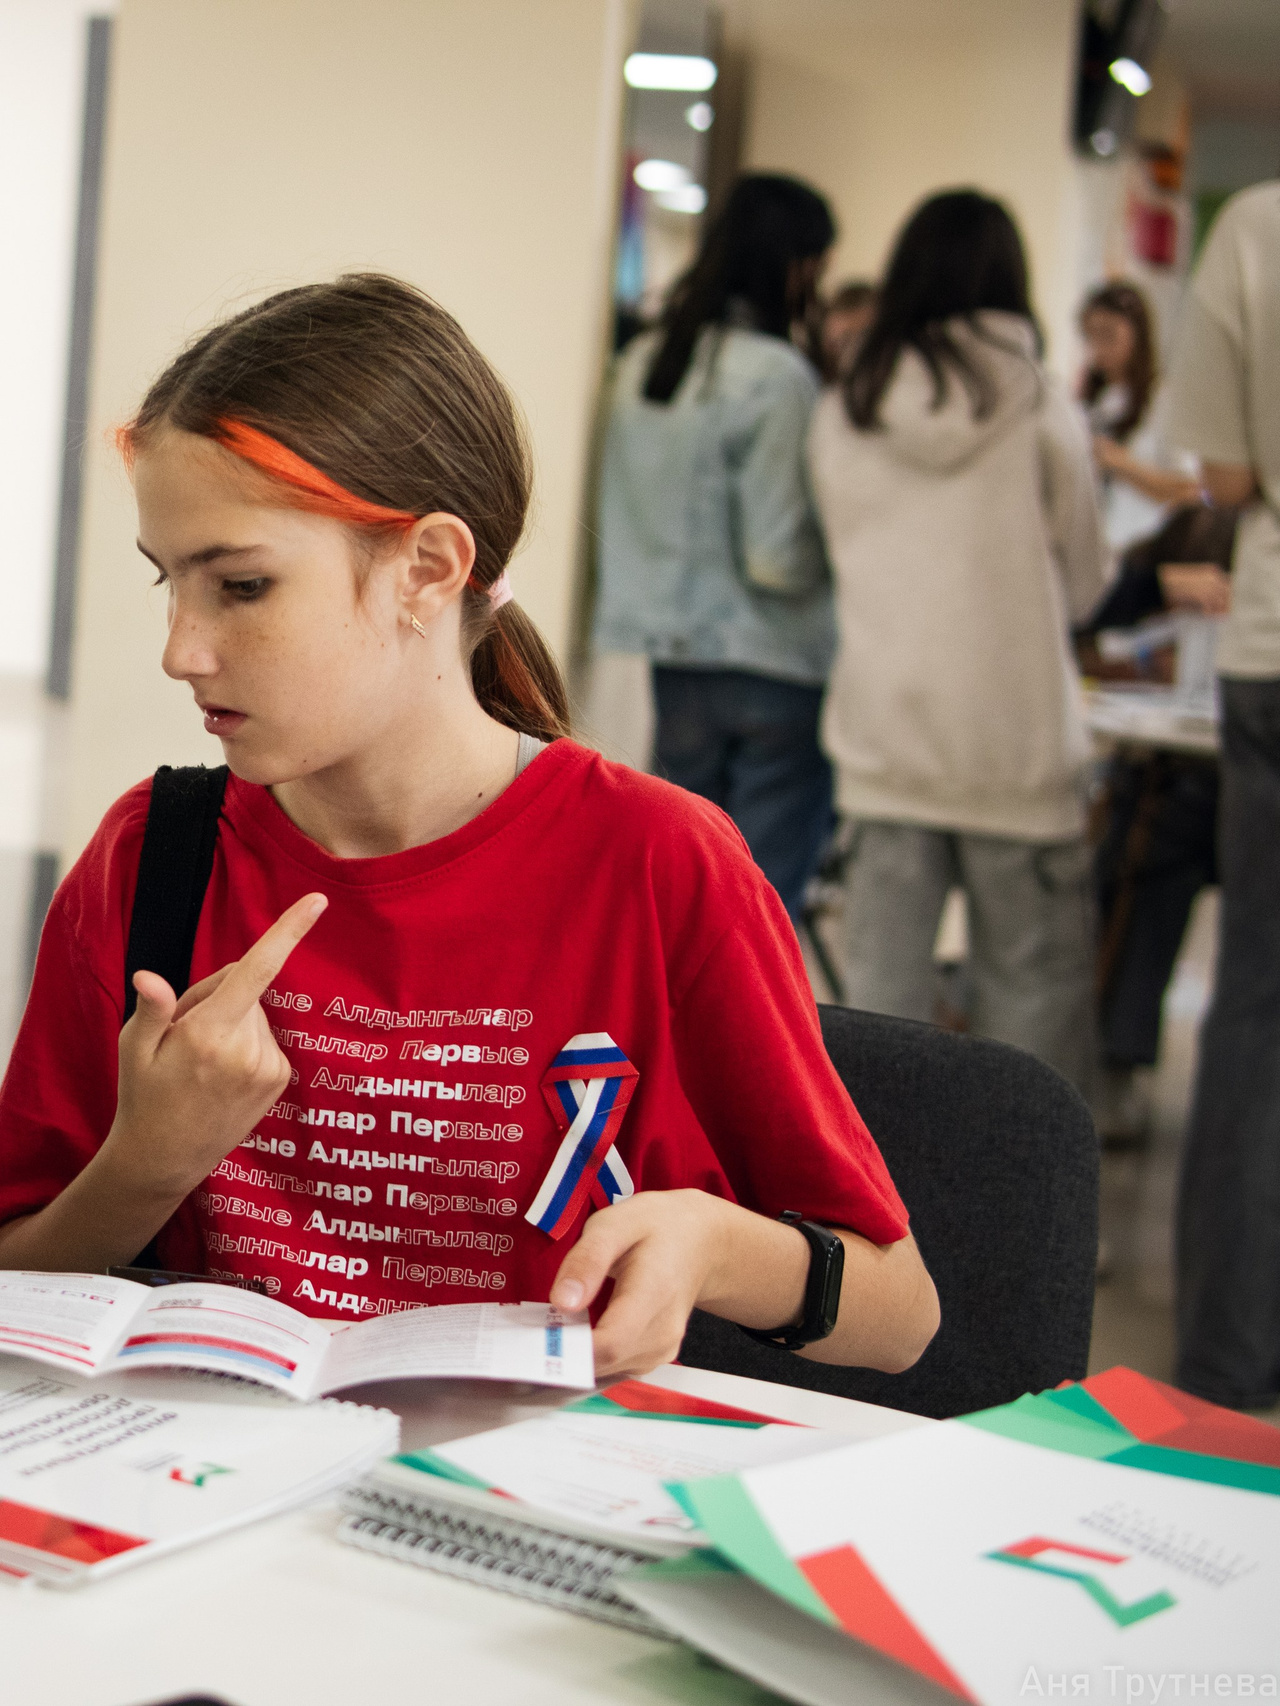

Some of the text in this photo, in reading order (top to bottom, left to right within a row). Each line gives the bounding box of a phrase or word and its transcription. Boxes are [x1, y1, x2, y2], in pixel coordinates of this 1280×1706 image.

[323, 996, 534, 1032] Алдынгылар
[270, 1026, 530, 1066] нгылар Первые
[310, 1066, 526, 1108] Алдынгылар
[390, 1110, 524, 1143] Первые
[307, 1140, 520, 1184] Алдынгылар
[386, 1183, 518, 1216] Первые
[303, 1209, 514, 1257] Алдынгылар
[203, 1229, 507, 1291] дынгылар Первые
[293, 1278, 429, 1315] Алдынг
